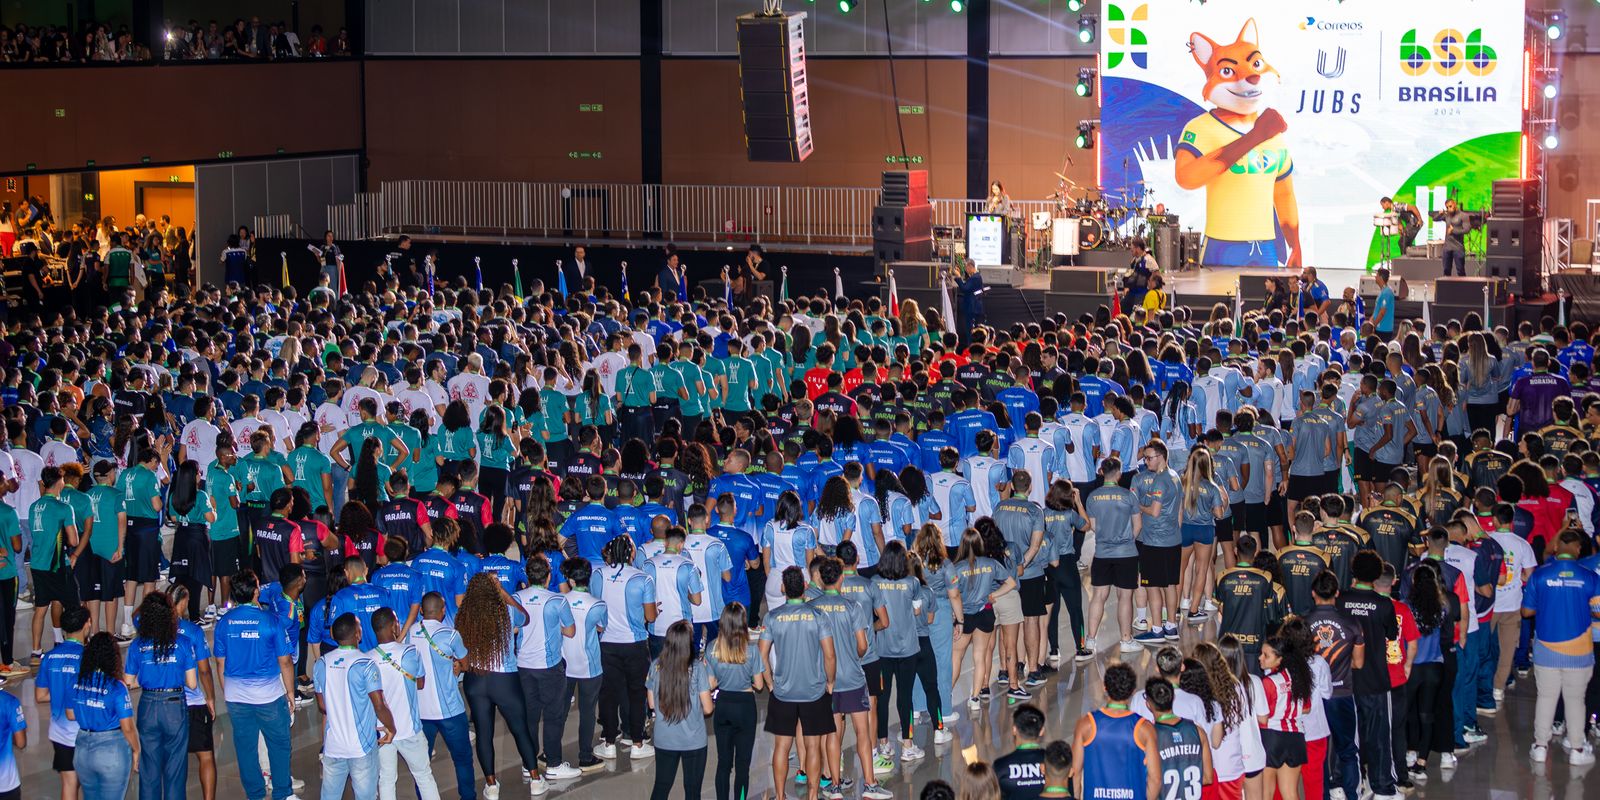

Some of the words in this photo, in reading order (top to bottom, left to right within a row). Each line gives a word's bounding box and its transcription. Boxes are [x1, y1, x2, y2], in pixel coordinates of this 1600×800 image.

[1317, 20, 1363, 30] Correios
[1399, 81, 1497, 102] BRASÍLIA
[567, 465, 592, 474] PARAÍBA
[455, 503, 474, 513] RAÍBA
[385, 510, 411, 521] PARAÍBA
[256, 529, 282, 542] PARAÍBA
[419, 558, 448, 567] PERNAMBUCO
[1290, 564, 1310, 573] JUBs
[1233, 585, 1252, 593] JUBs
[1344, 602, 1377, 610] EDUCAÇÃO
[776, 614, 799, 622] TIME
[800, 613, 814, 621] RS
[1160, 744, 1200, 760] CUBATELLI
[1163, 765, 1201, 800] 23
[1094, 787, 1134, 800] ATLETISMO
